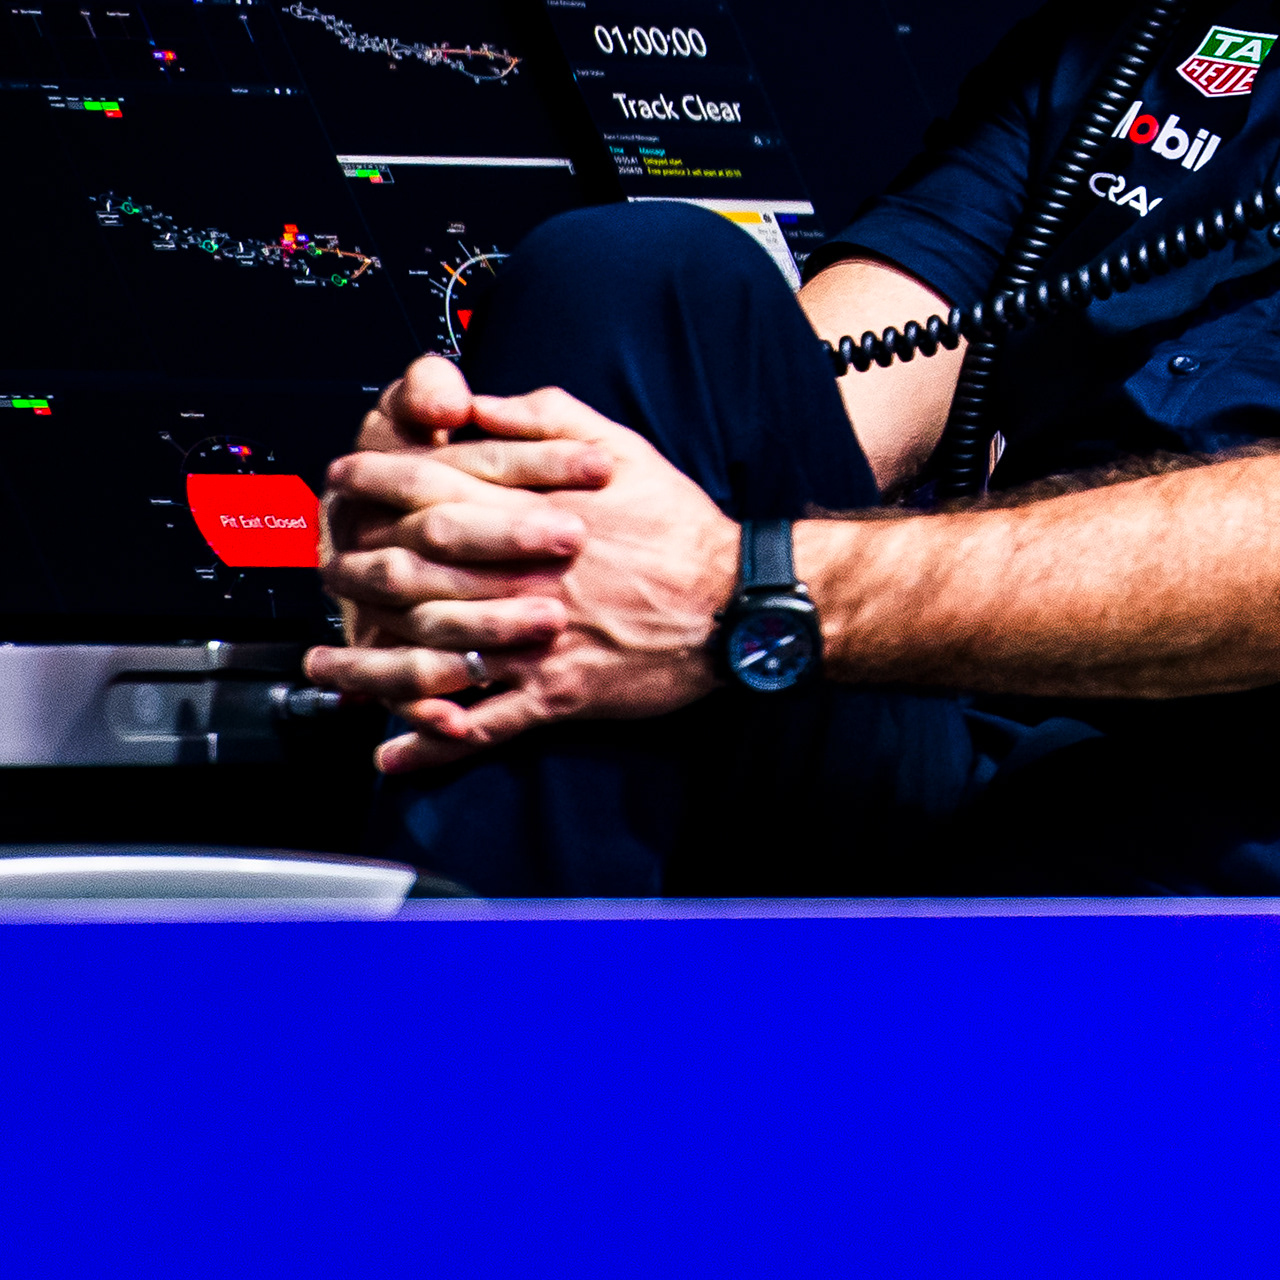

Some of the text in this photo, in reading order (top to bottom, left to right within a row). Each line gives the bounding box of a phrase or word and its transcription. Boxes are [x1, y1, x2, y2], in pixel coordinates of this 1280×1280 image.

[594, 25, 707, 57] 01:00:00
[1214, 33, 1264, 62] TA
[1185, 59, 1259, 94] HEUE
[612, 92, 742, 122] Track Clear
[220, 515, 308, 529] Pit Exit Closed
